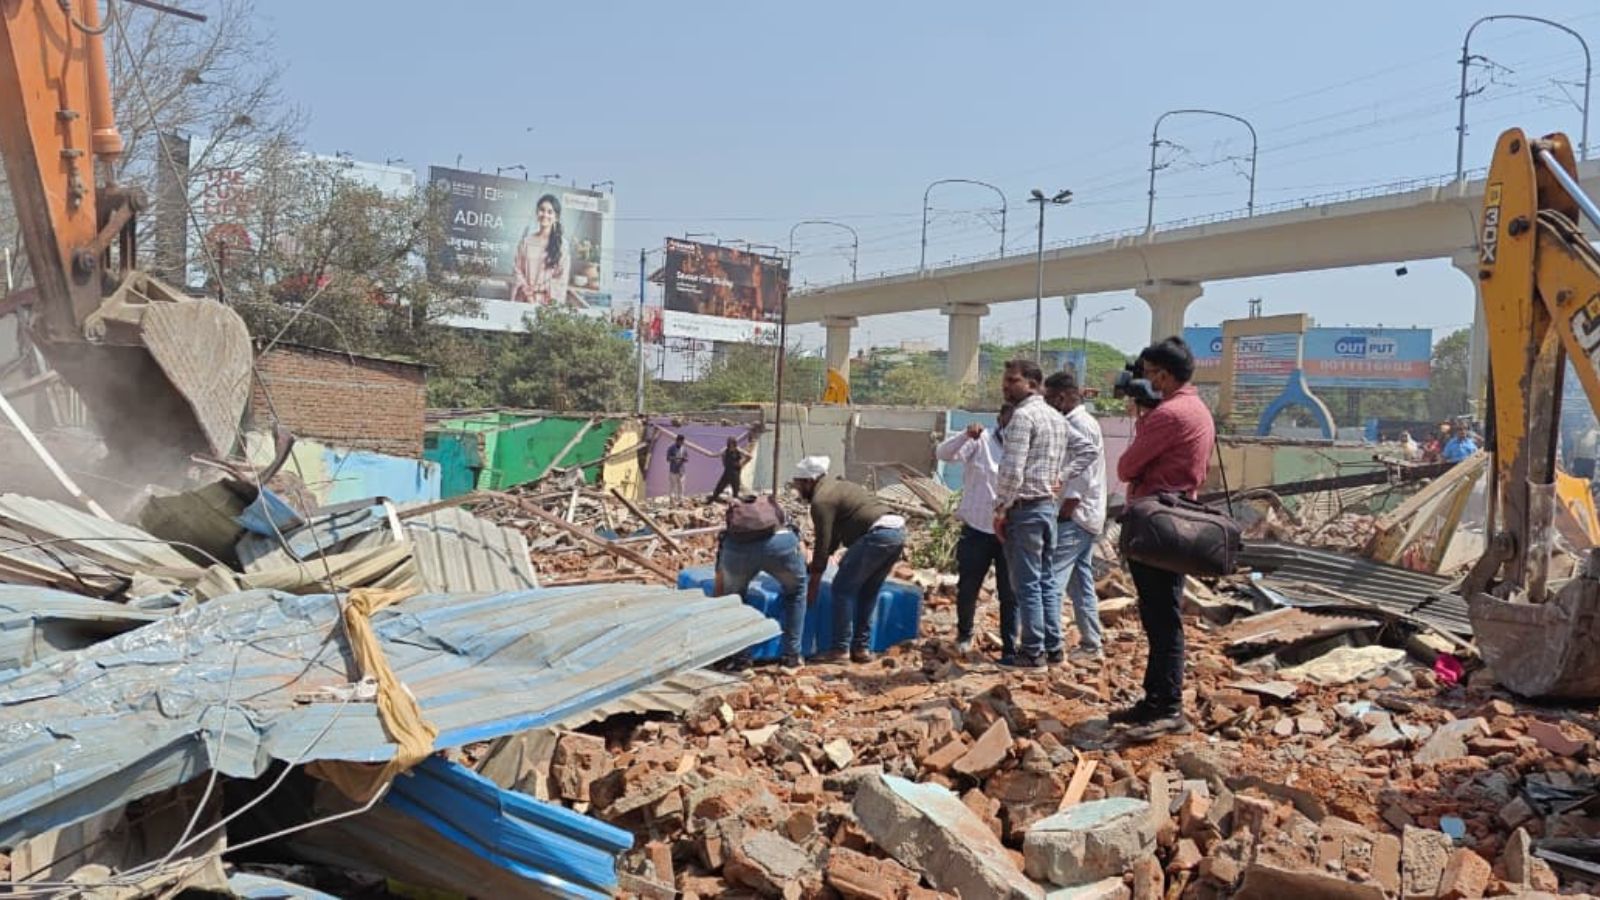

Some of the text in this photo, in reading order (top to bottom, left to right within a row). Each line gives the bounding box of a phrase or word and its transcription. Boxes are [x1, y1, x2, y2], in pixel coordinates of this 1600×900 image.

[453, 209, 504, 229] ADIRA
[1336, 342, 1395, 354] OUT PUT
